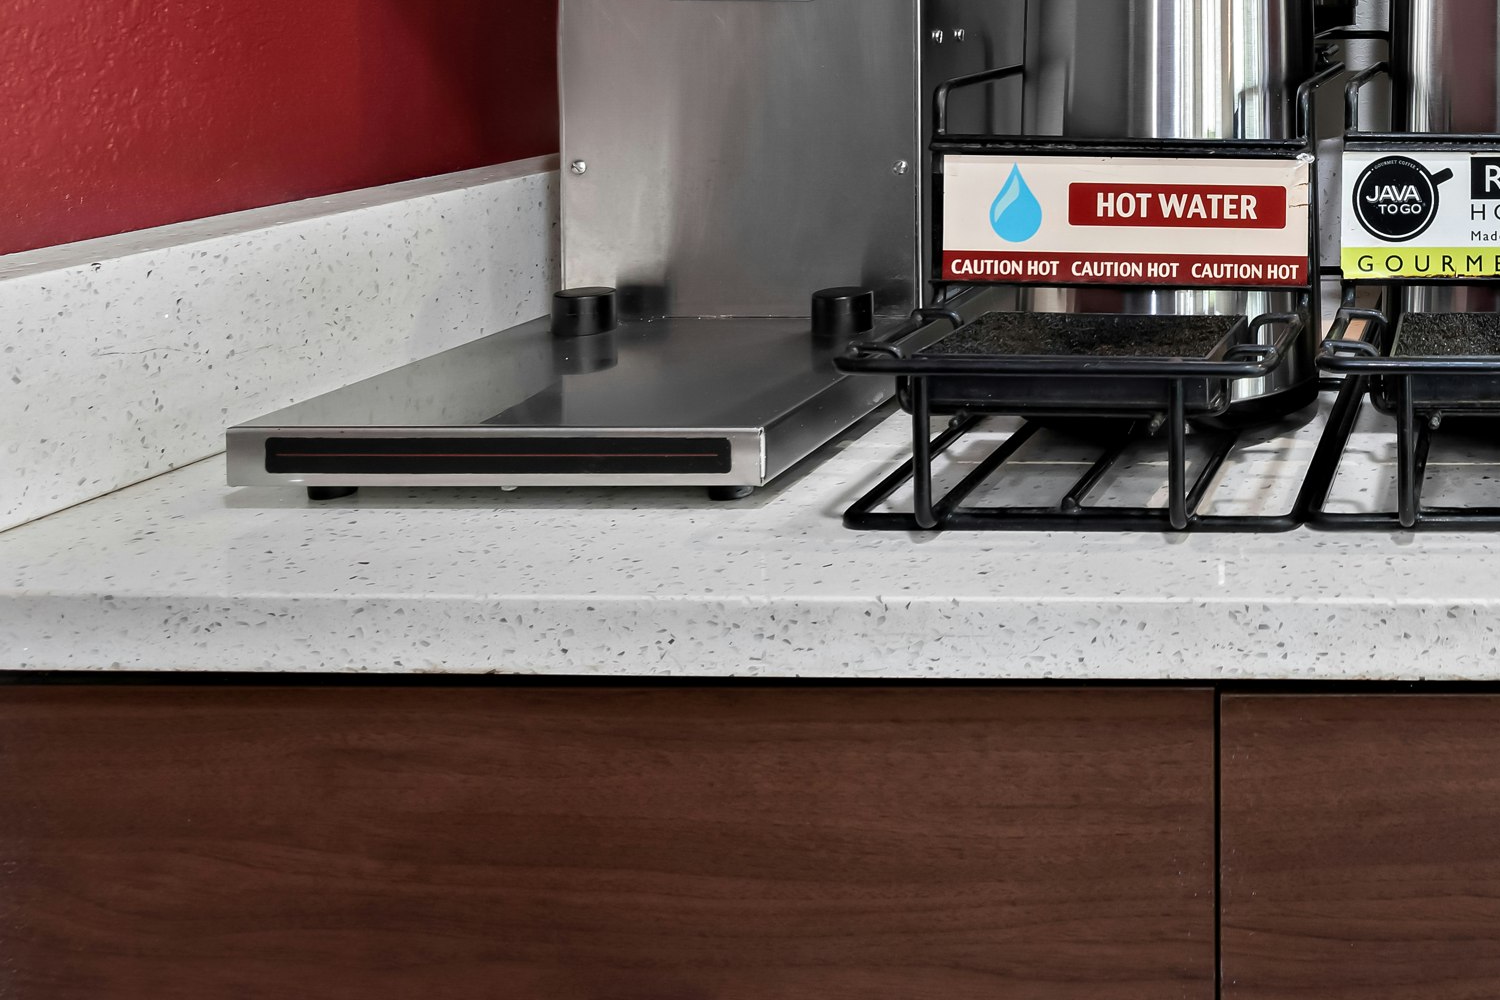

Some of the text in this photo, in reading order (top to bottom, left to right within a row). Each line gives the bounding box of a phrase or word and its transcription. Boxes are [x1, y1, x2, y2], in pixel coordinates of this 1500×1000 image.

[1374, 160, 1416, 170] GOURMET COFFEE
[1365, 185, 1421, 202] JAVA
[1096, 192, 1258, 220] HOT WATER
[1378, 203, 1422, 215] TO GO
[951, 258, 1300, 280] CAUTION HOT CAUTION HOT CAUTION HOT
